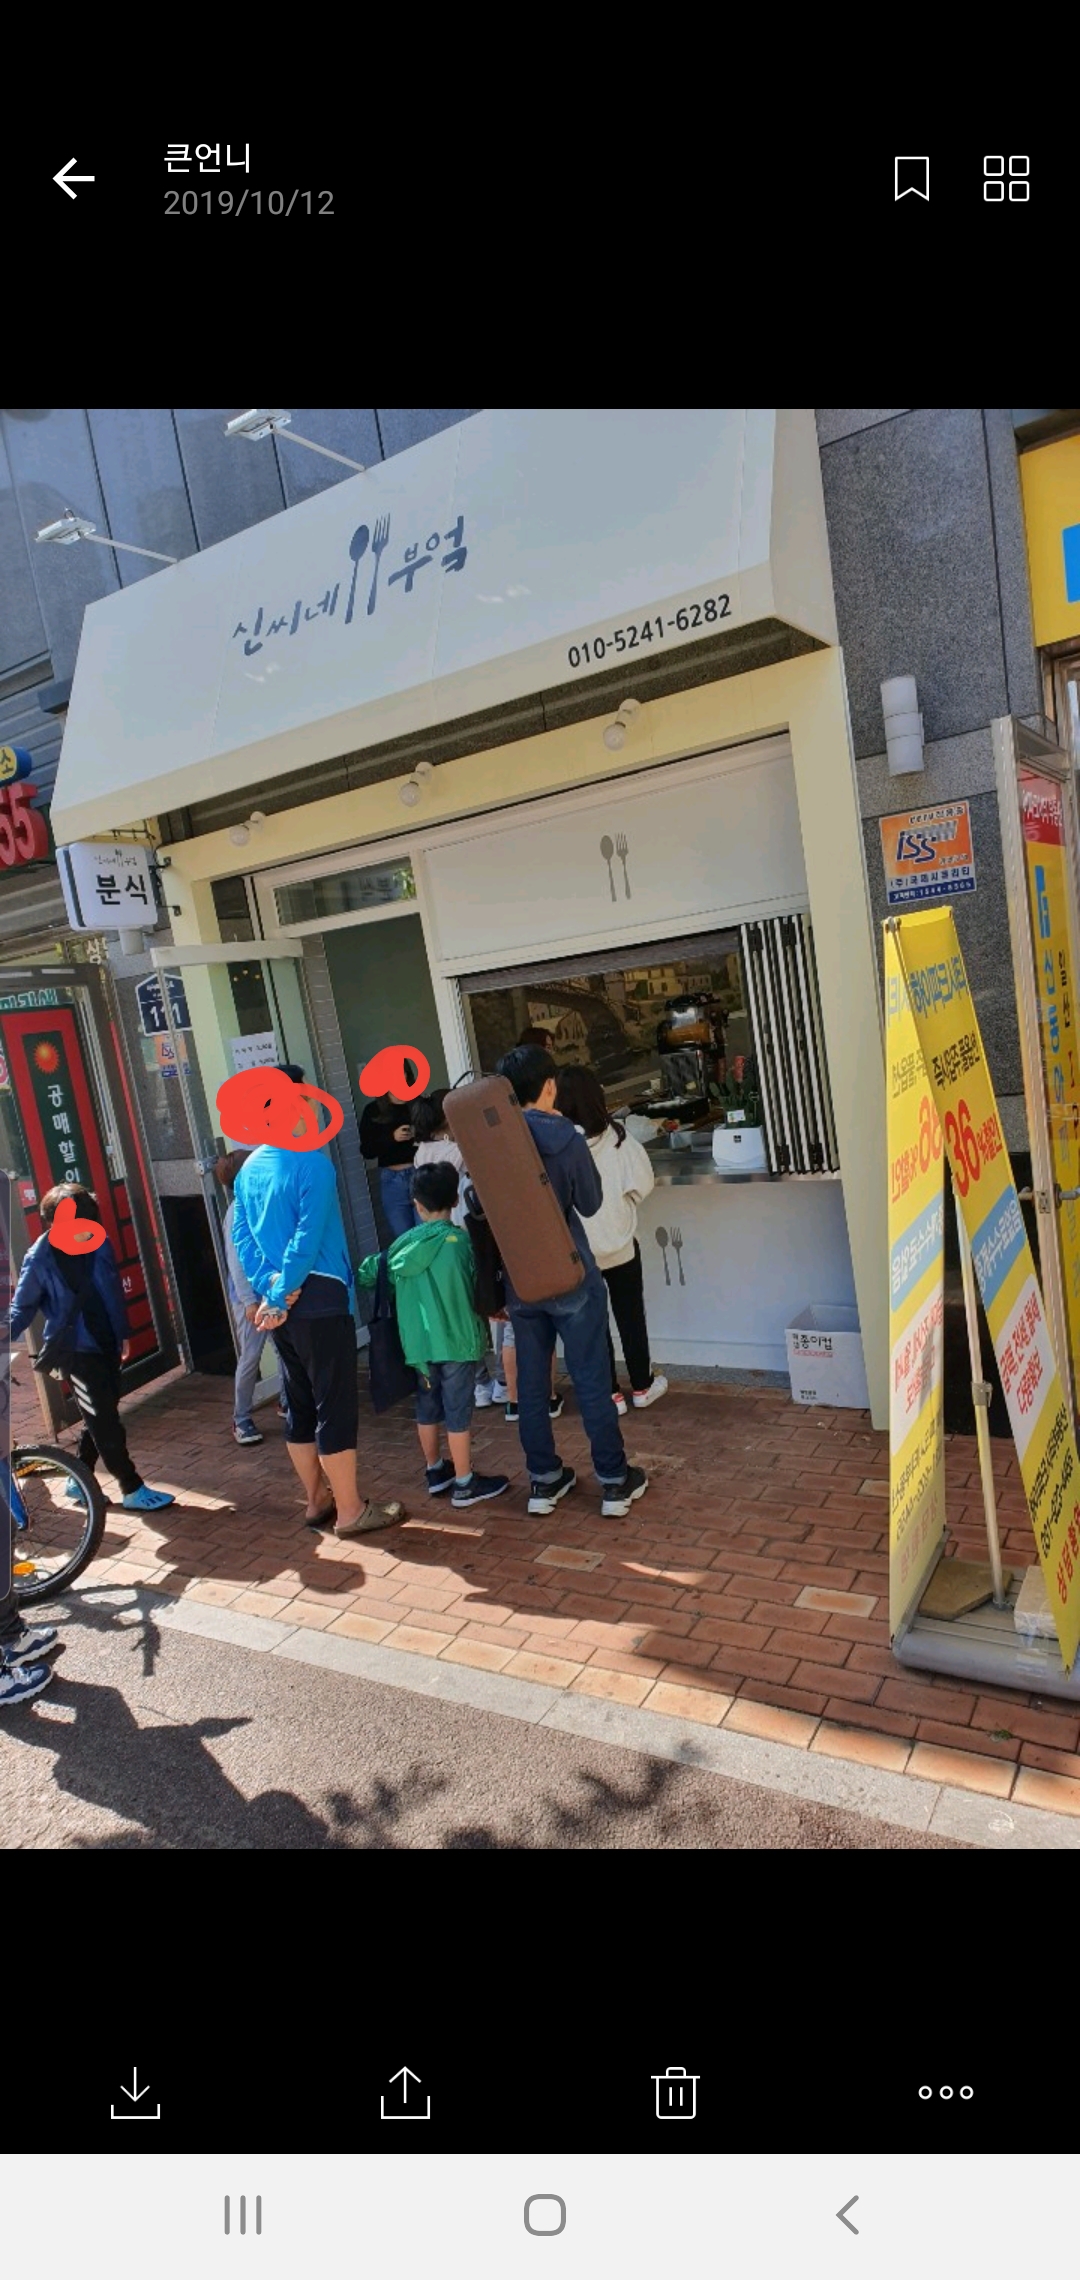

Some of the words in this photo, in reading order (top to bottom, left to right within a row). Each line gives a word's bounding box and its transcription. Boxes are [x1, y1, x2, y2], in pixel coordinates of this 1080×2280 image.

[232, 583, 340, 656] 신씨네
[388, 515, 467, 593] 부엌
[568, 593, 732, 668] 010-5241-6282
[95, 873, 148, 906] 분식
[150, 1002, 183, 1027] 11
[800, 1334, 833, 1351] 종이컵
